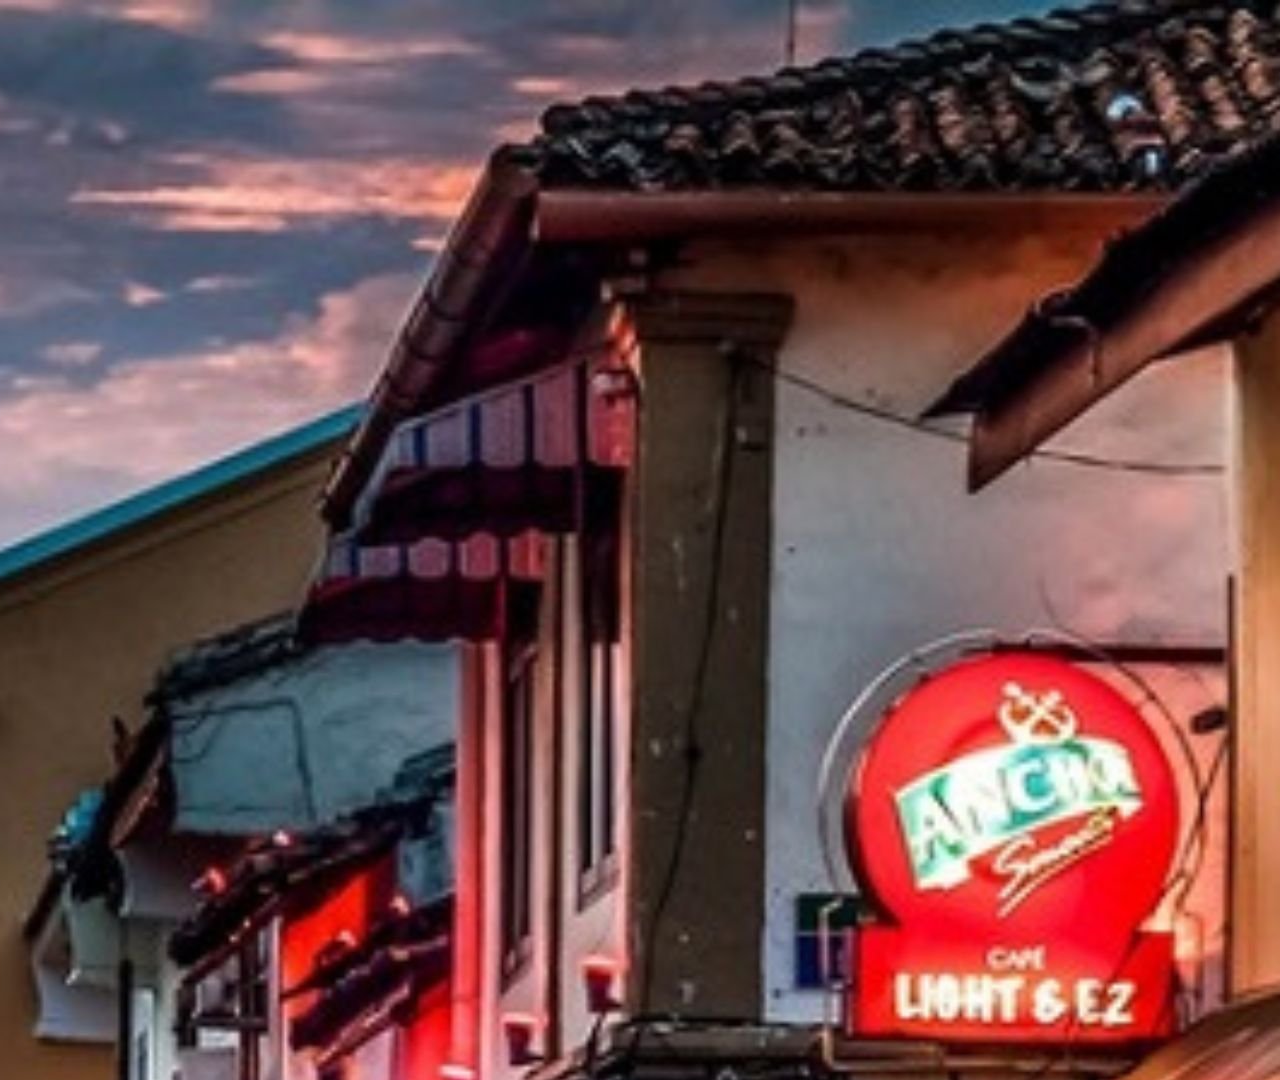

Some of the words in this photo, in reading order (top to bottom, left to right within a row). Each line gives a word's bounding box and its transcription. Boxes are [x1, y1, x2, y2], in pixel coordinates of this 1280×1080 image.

[895, 973, 1024, 1023] LIGHT
[1033, 977, 1067, 1024] &
[1076, 978, 1137, 1027] EZ
